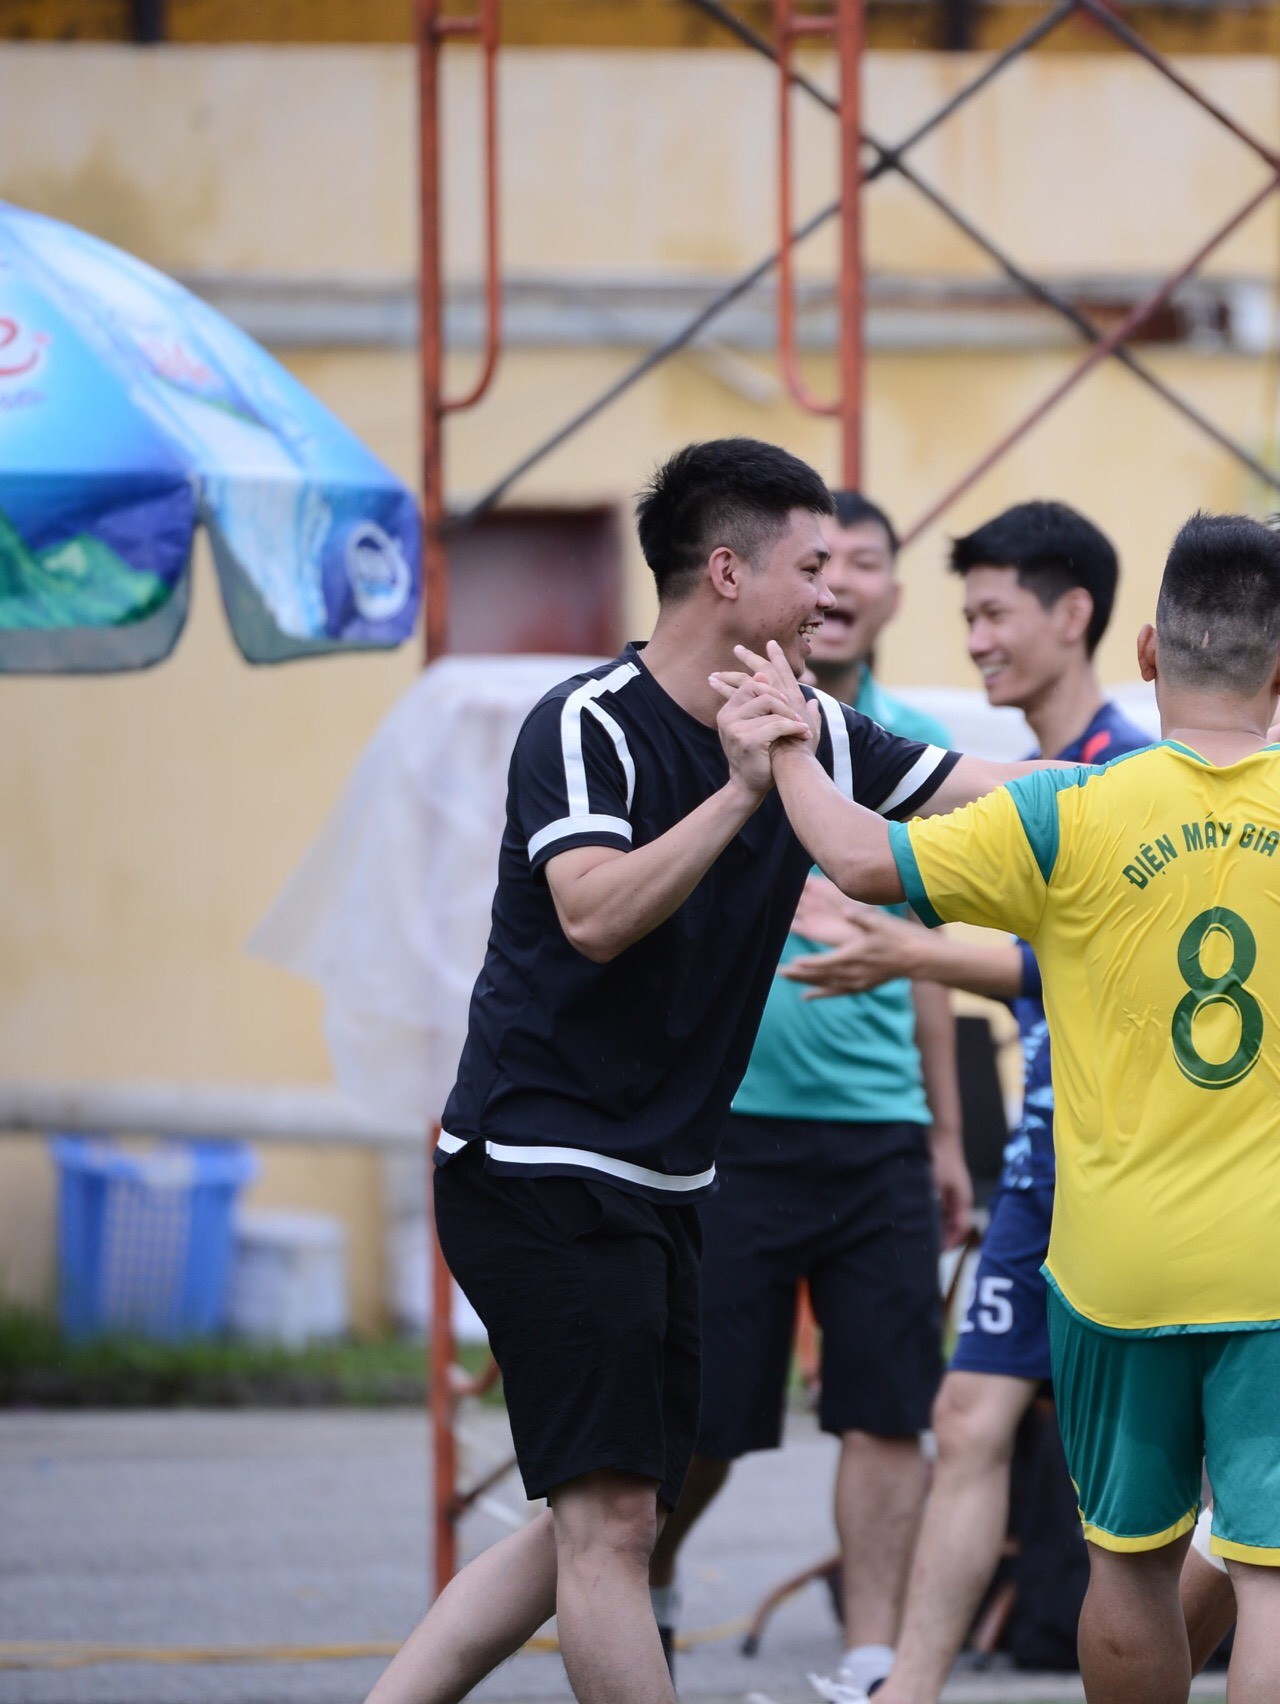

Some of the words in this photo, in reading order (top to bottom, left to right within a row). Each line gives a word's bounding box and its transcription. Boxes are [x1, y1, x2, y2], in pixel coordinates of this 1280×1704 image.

[1122, 834, 1179, 890] ĐIỆN
[1181, 811, 1233, 852] MÁY
[1238, 822, 1280, 857] GIA
[1171, 906, 1264, 1090] 8
